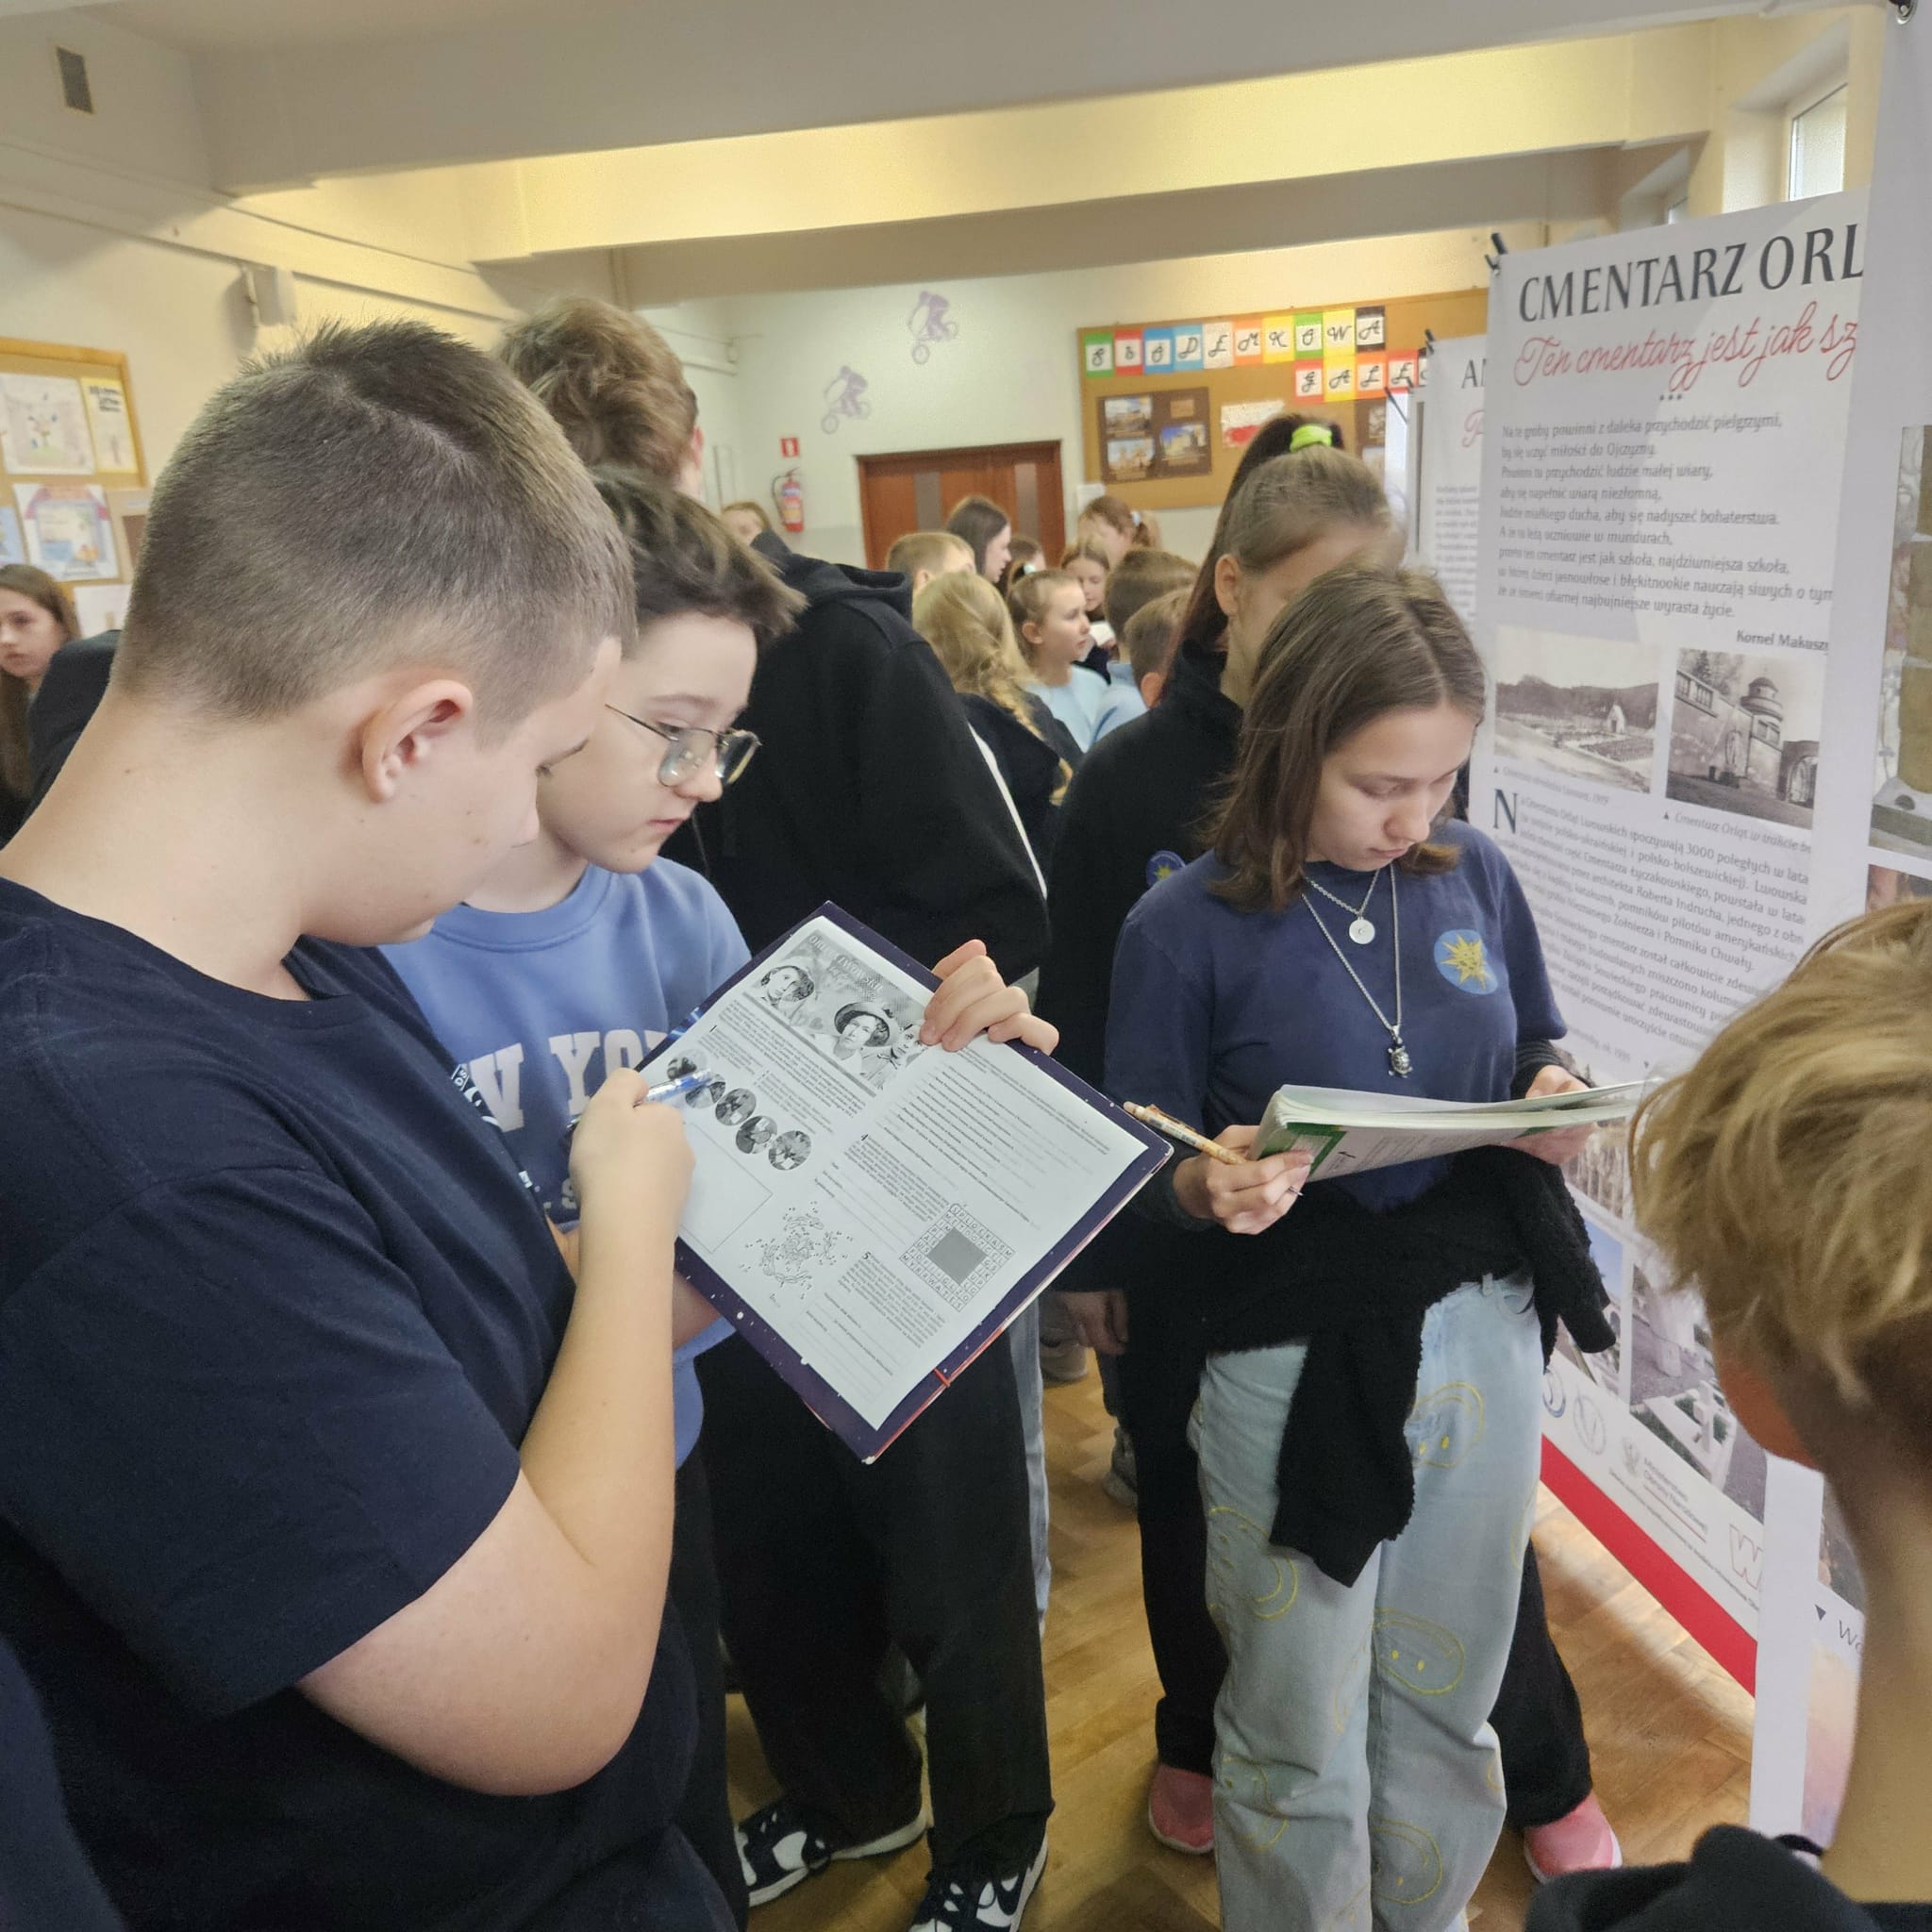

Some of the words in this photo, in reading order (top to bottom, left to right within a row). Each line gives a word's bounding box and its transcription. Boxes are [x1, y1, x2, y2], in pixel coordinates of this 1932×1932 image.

[1519, 242, 1747, 323] CMENTARZ
[1514, 333, 1571, 387] Ten
[1575, 326, 1699, 391] cmentarz
[1680, 317, 1761, 391] jest
[1739, 301, 1818, 388] jak
[1552, 422, 1596, 439] powinni
[1607, 419, 1641, 435] daleka
[1645, 415, 1709, 436] przychodzić
[1713, 411, 1782, 434] pielgrzymi,
[1549, 443, 1587, 458] miłości
[1590, 442, 1605, 457] do
[1545, 463, 1603, 482] przychodzić
[1607, 463, 1639, 477] ludzie
[1642, 463, 1673, 479] małej
[1675, 463, 1713, 482] wiary,
[1569, 488, 1598, 502] wiarą
[1600, 486, 1661, 503] niezłomną,
[1568, 508, 1602, 522] ducha,
[1605, 508, 1625, 525] aby
[1628, 509, 1643, 525] się
[1646, 508, 1697, 526] nadyszeć
[1700, 509, 1780, 525] bohaterstwa.
[1607, 530, 1673, 545] mundurach,
[1579, 552, 1597, 566] jest
[1599, 551, 1616, 566] jak
[1618, 552, 1656, 567] szkoła,
[1658, 555, 1743, 574] najdziwniejsza
[1747, 558, 1790, 575] szkoła,
[1620, 573, 1690, 592] błękitnookie
[1692, 579, 1744, 599] nauczają
[1747, 583, 1792, 602] siwych
[1796, 589, 1806, 600] o
[1581, 593, 1651, 611] najbujniejsze
[1653, 600, 1699, 616] wyrasta
[1702, 602, 1735, 620] życie.
[1736, 629, 1774, 646] Kornel
[1685, 842, 1714, 860] 3000
[1717, 852, 1771, 875] poległych
[1773, 867, 1785, 878] w
[1714, 891, 1764, 914] powstała
[1767, 906, 1778, 918] w
[1755, 879, 1808, 906] Lwowska
[1618, 899, 1669, 924] pomników
[1672, 916, 1711, 937] pilotów
[1636, 885, 1674, 907] Roberta
[1726, 911, 1772, 936] jednego
[1663, 929, 1707, 956] Pomnika
[1640, 945, 1668, 965] został
[1670, 957, 1724, 984] całkowicie
[1647, 968, 1699, 994] zniszczono
[1649, 990, 1707, 1019] pracownicy
